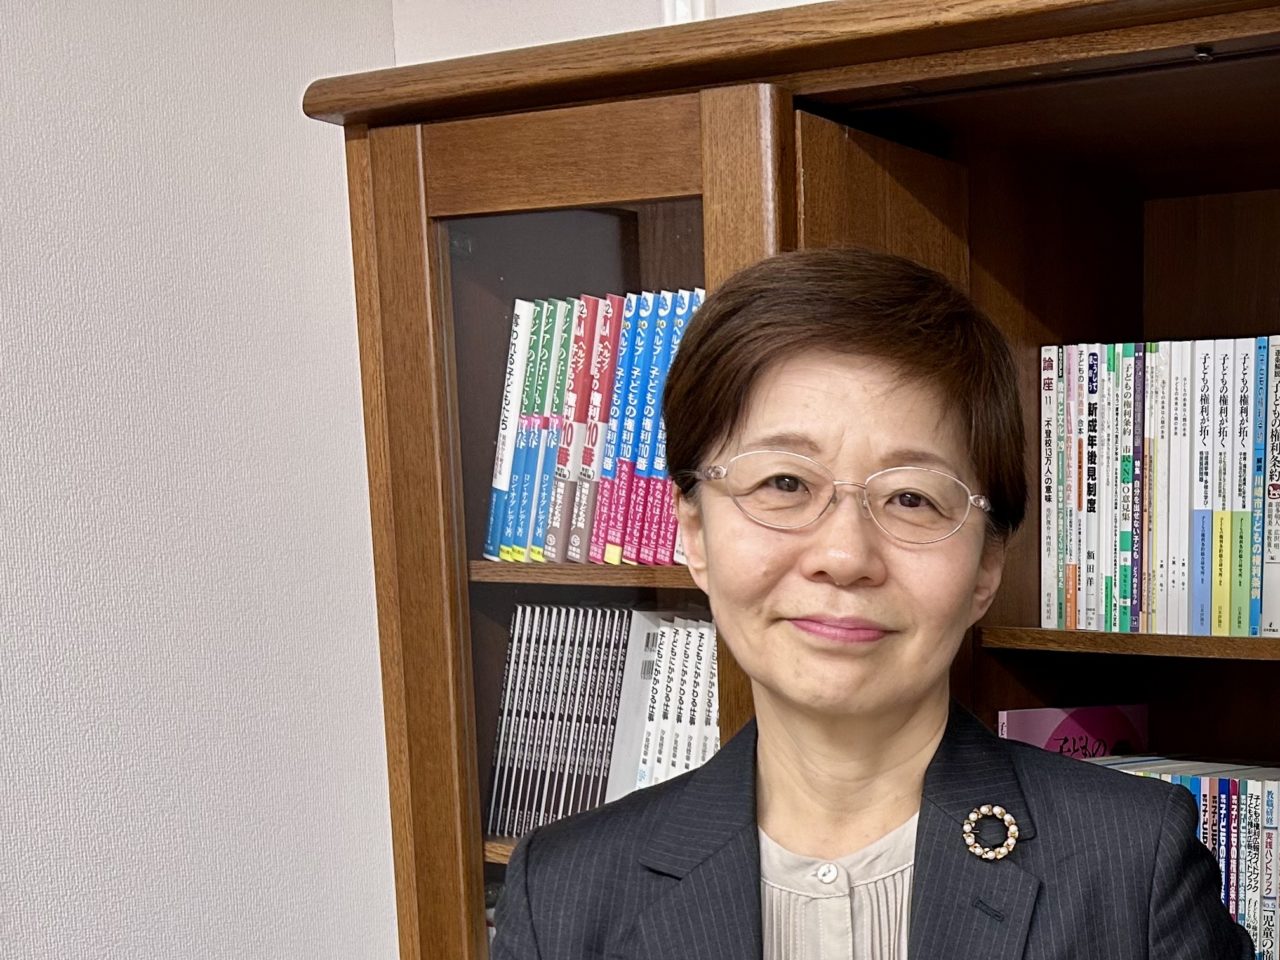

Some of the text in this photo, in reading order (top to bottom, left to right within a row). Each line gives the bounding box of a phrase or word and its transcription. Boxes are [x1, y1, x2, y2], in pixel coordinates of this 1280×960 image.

[501, 313, 520, 430] 奪われる子どもたち
[1043, 357, 1054, 391] 論座
[1199, 353, 1210, 447] 子どもの権利が拓く
[1219, 353, 1229, 448] 子どもの権利が拓く
[1238, 353, 1249, 448] 子どもの権利が拓く
[1087, 402, 1098, 513] 新成年後見制度
[1264, 832, 1275, 895] 実践ハンドブック
